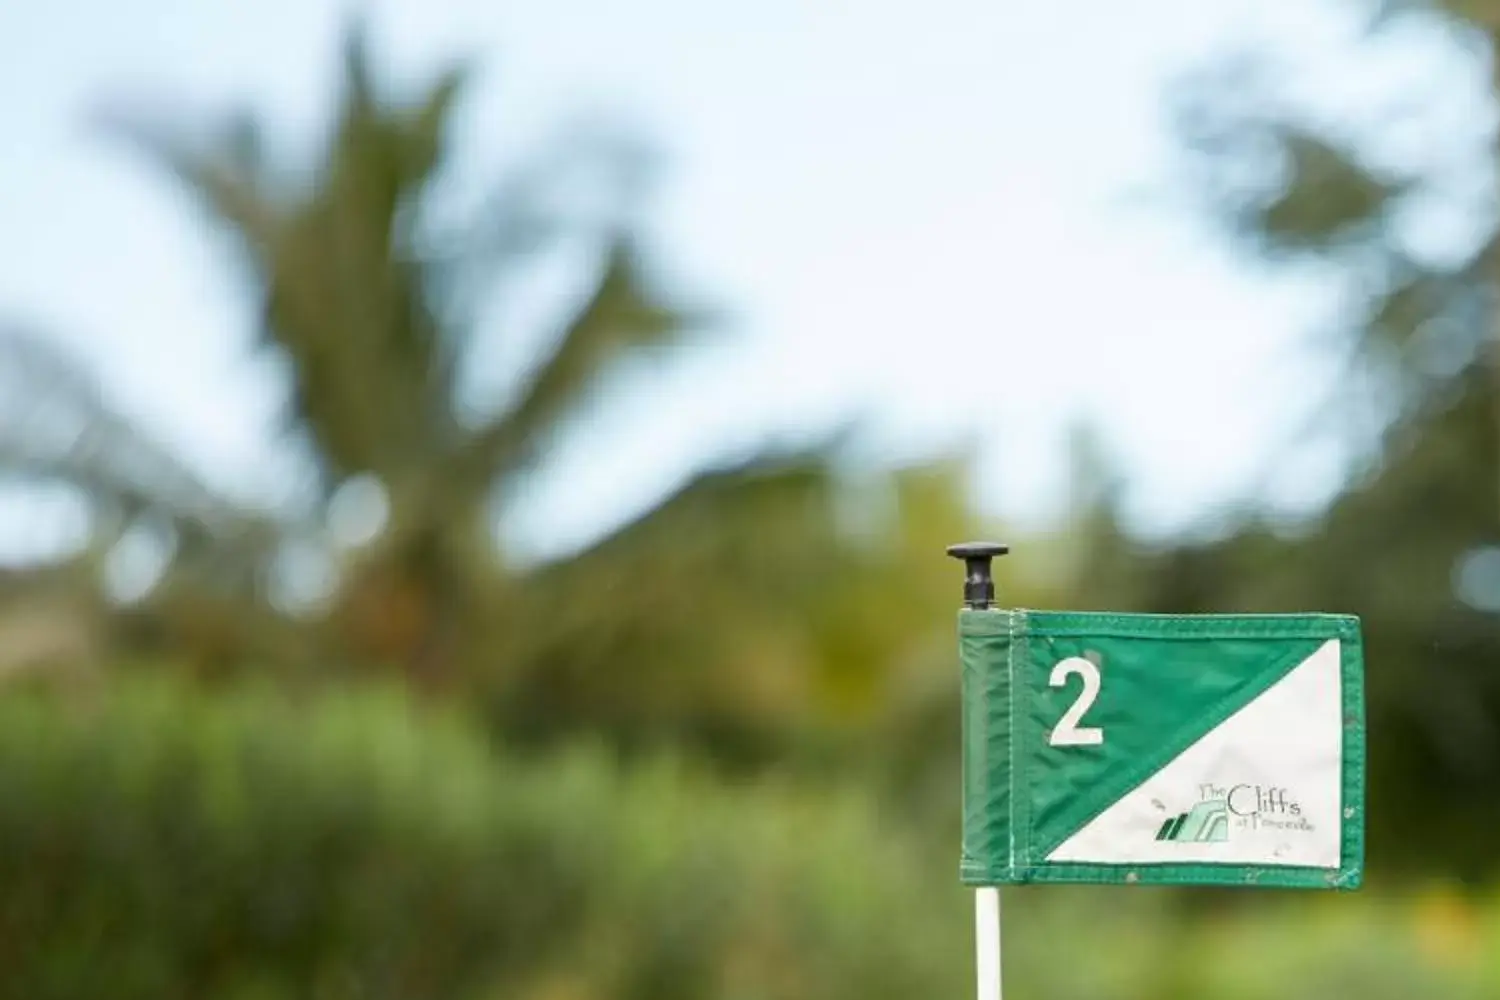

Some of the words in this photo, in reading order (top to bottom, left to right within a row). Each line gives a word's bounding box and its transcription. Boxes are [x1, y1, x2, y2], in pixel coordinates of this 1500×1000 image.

[1049, 656, 1103, 746] 2
[1199, 783, 1226, 800] The
[1227, 783, 1301, 816] Cliffs
